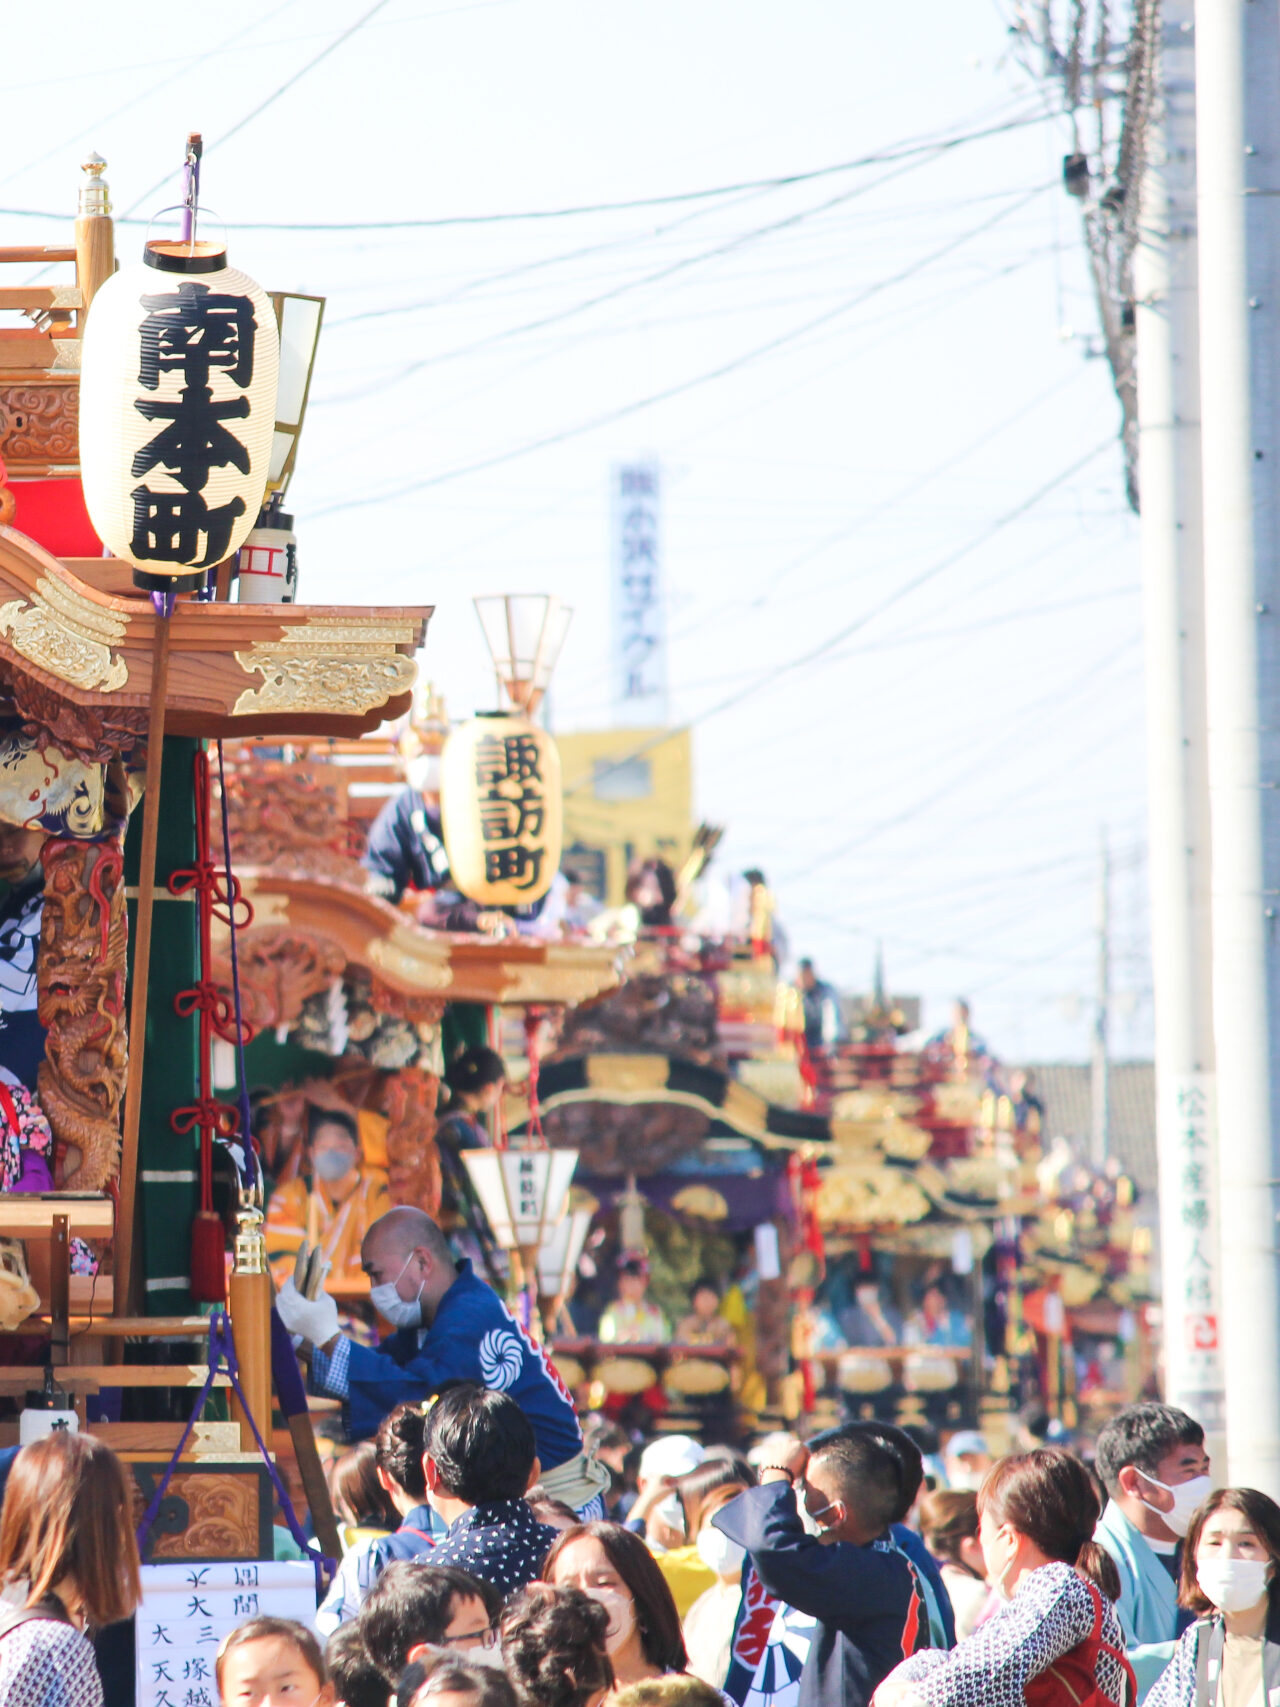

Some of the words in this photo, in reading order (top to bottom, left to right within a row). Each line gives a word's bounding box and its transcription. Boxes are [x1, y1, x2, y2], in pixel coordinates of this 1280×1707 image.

[130, 282, 258, 568] 南本町
[476, 734, 544, 890] 諏訪町
